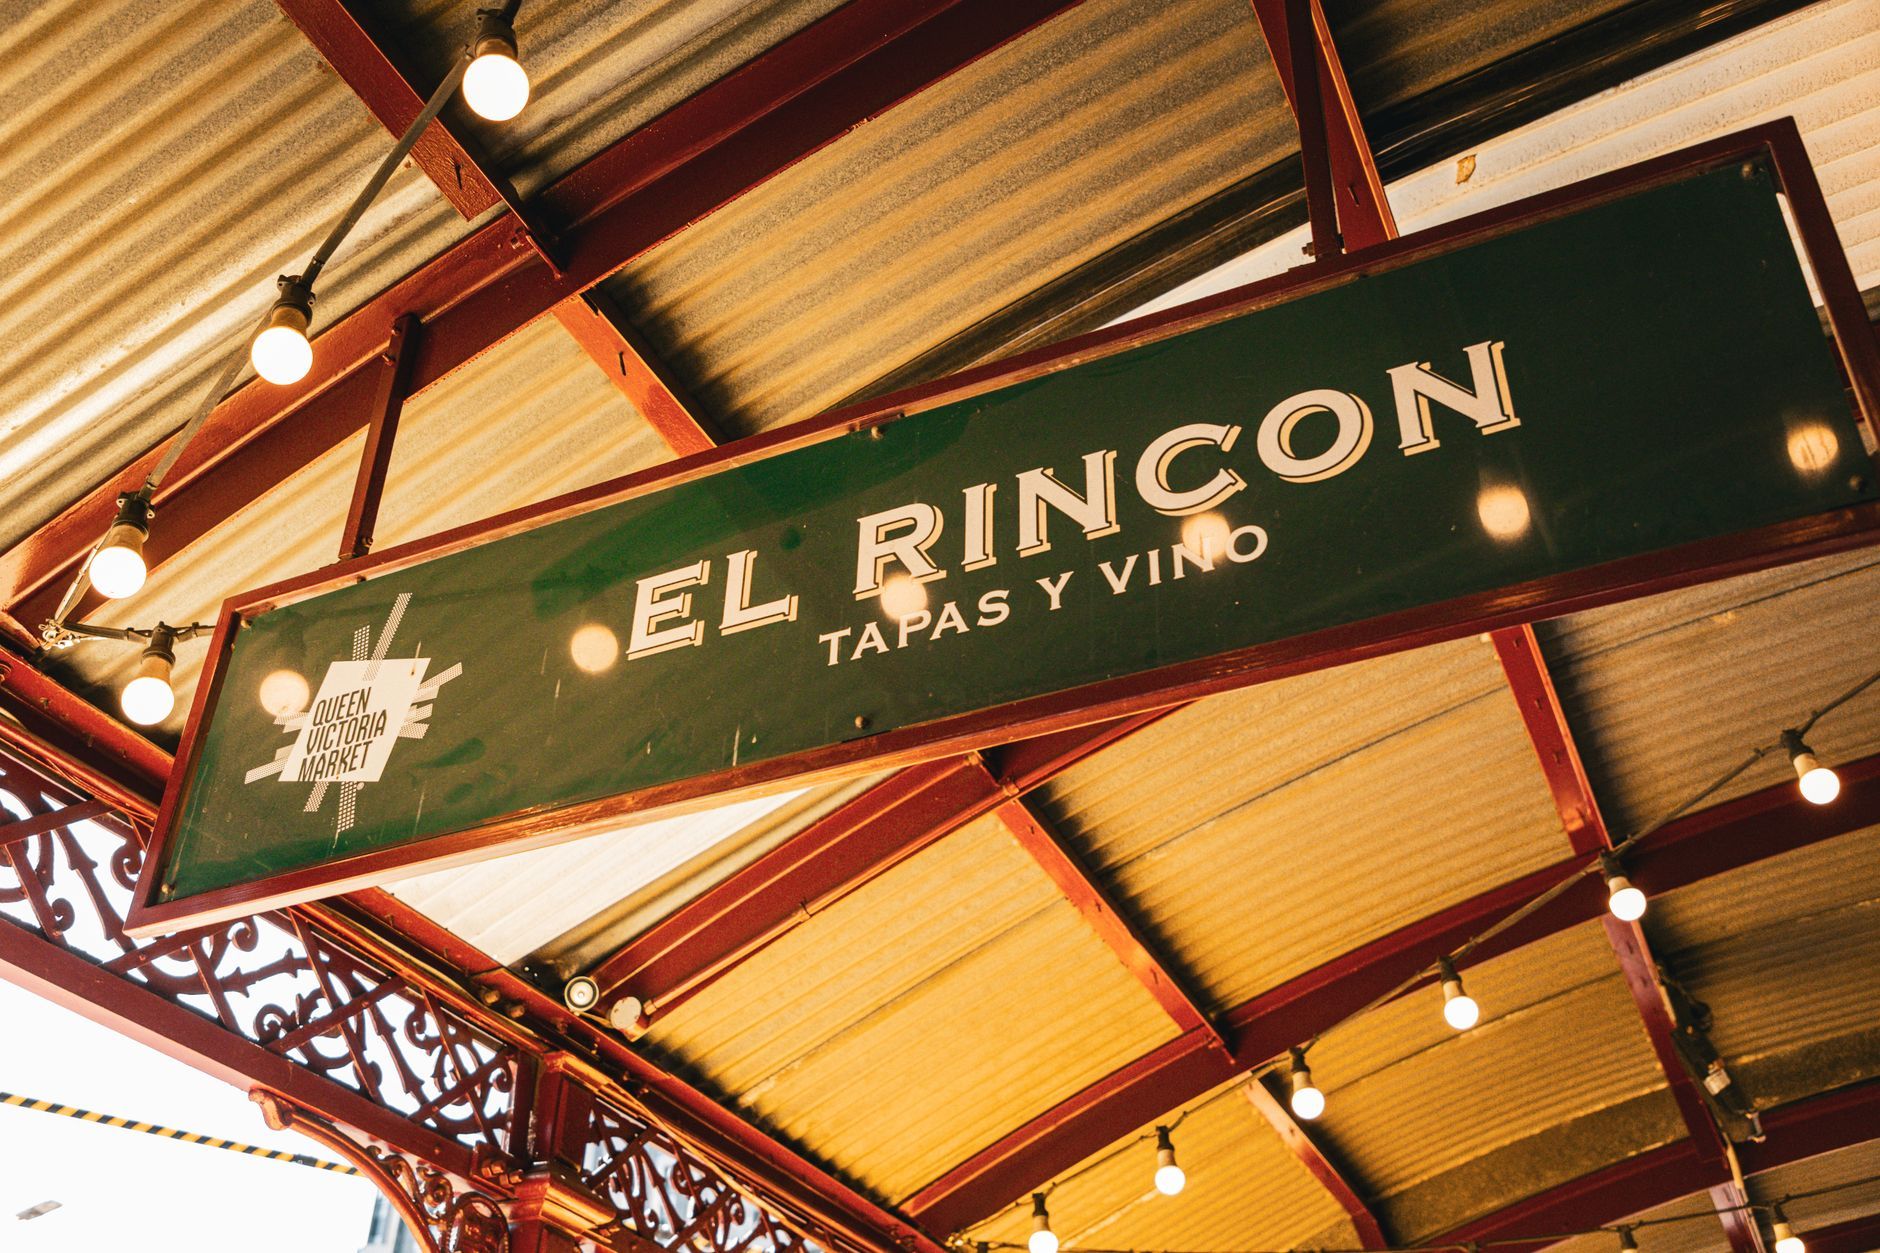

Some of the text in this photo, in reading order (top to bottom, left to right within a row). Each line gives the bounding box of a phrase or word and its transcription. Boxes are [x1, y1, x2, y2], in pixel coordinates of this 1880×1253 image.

[626, 340, 1521, 661] EL RINCON
[818, 524, 1268, 667] TAPAS Y VINO
[312, 687, 371, 726] QUEEN
[306, 709, 387, 755] VICTORIA
[298, 740, 373, 781] MARKET
